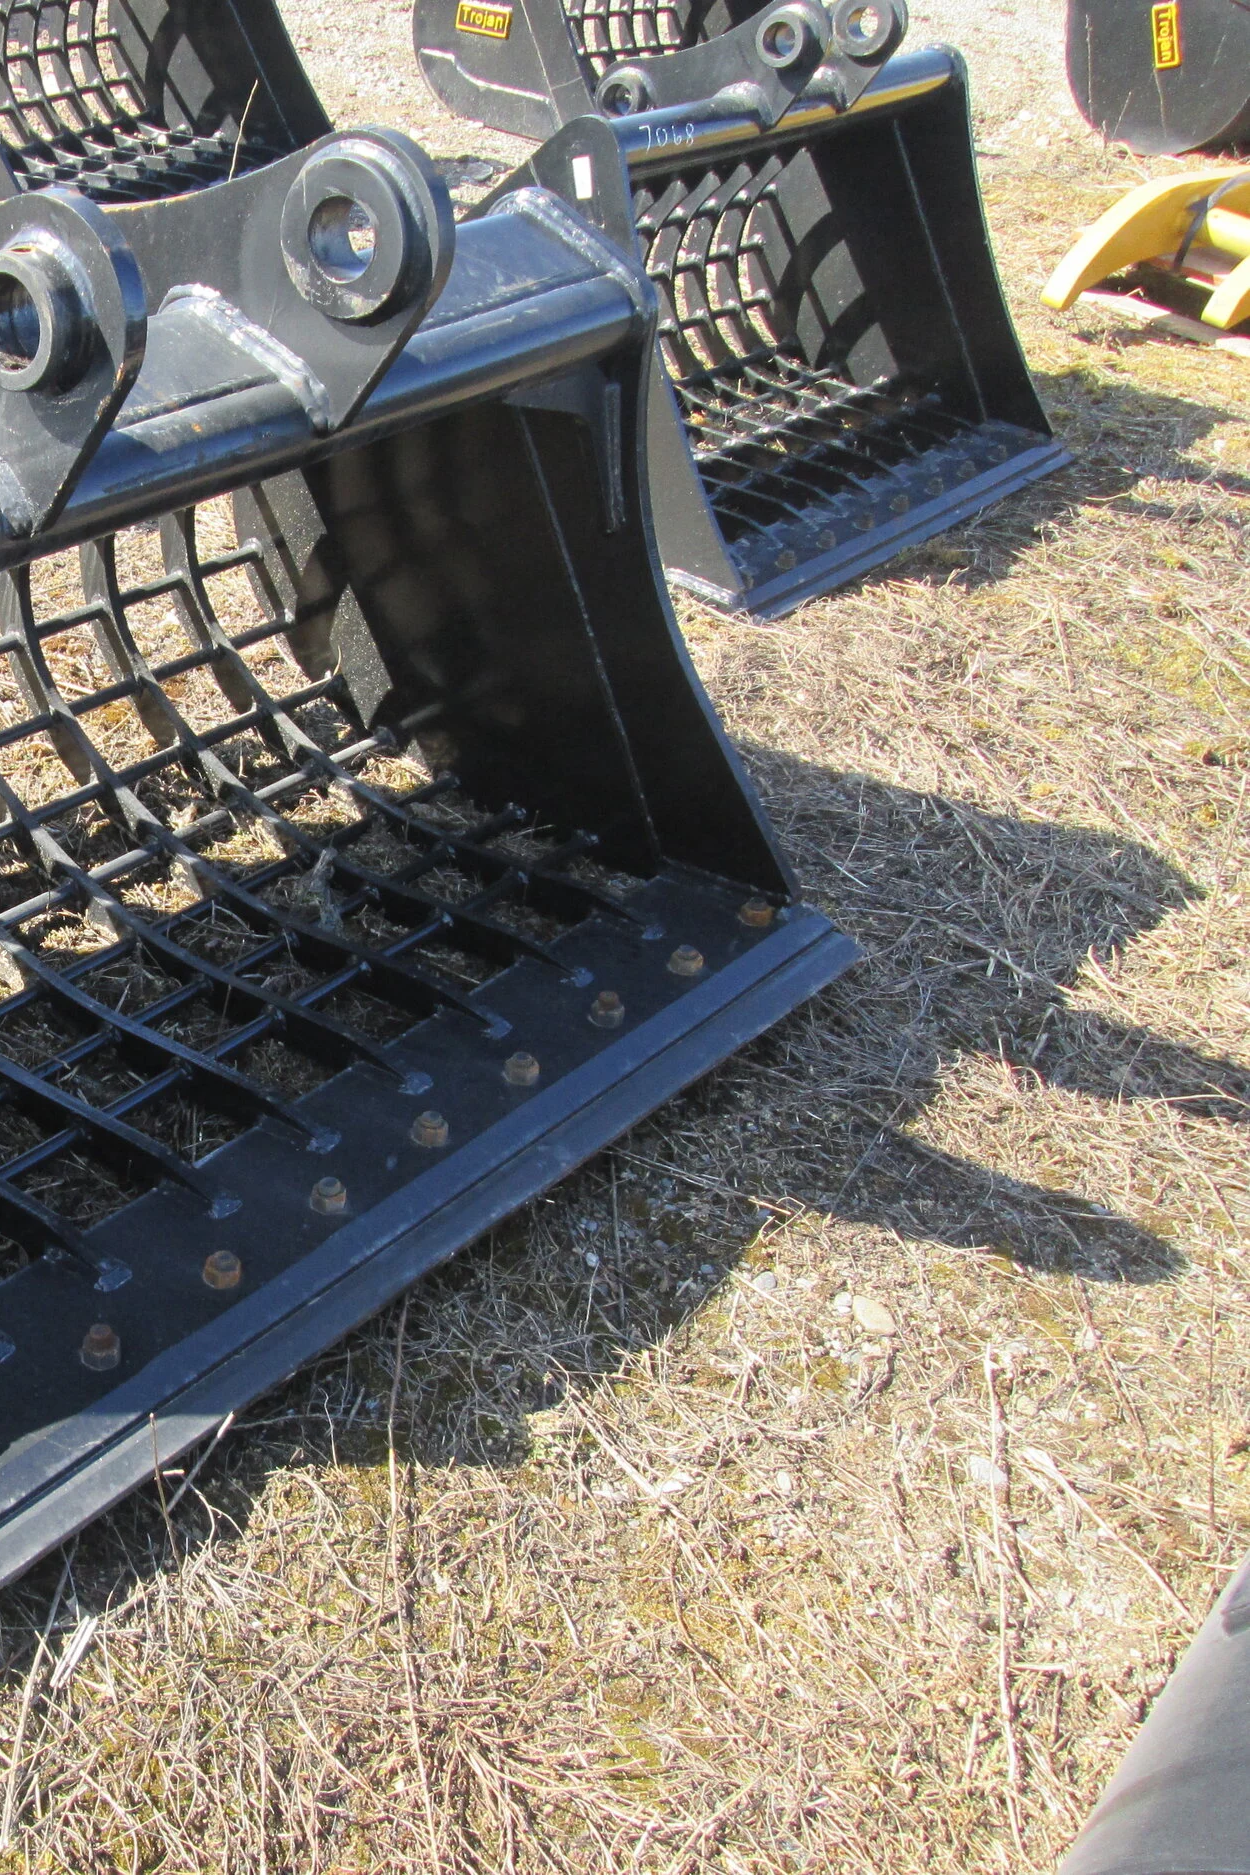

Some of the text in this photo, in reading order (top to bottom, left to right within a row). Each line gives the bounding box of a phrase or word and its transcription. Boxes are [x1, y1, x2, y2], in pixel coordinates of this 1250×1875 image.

[462, 6, 503, 31] Trojan
[1158, 8, 1173, 62] Trojan
[638, 122, 695, 155] 7068
